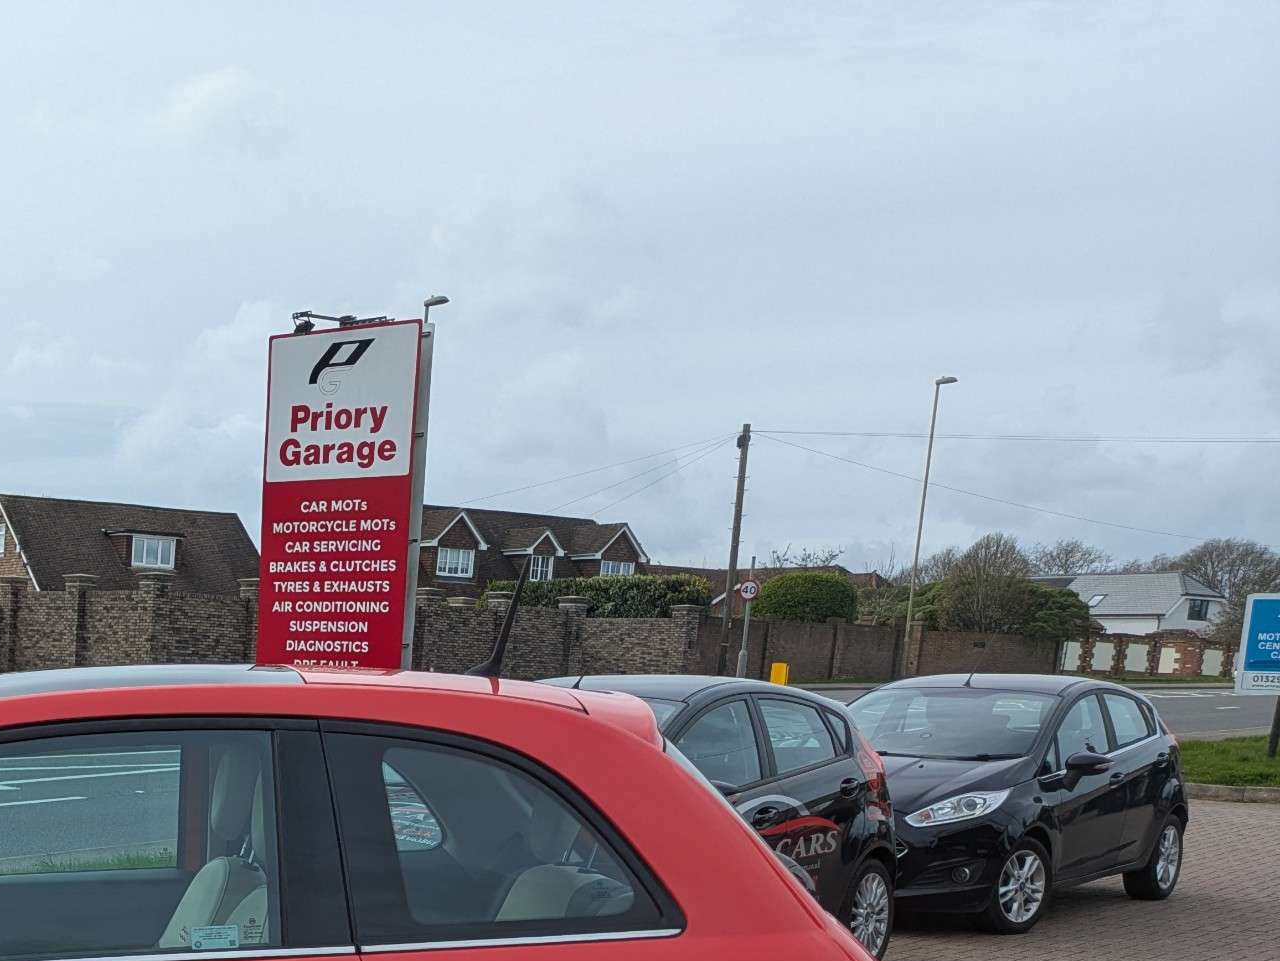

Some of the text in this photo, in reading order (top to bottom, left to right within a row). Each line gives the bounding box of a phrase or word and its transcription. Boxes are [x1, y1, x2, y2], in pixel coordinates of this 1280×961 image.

[291, 402, 388, 433] Priory
[280, 438, 397, 469] Garage
[301, 499, 368, 513] CAR MOTs
[272, 519, 396, 534] MOTORCYCLE MOTs
[285, 539, 381, 553] CAR SERVICING
[269, 560, 397, 573] BRAKES & CLUTCHES
[273, 580, 390, 593] TYRES & EXHAUSTS
[741, 585, 756, 595] 40
[272, 601, 390, 613] AIR CONDITIONING
[289, 620, 368, 633] SUSPENSION
[285, 640, 369, 653] DIAGNOSTICS
[775, 830, 838, 859] CARS
